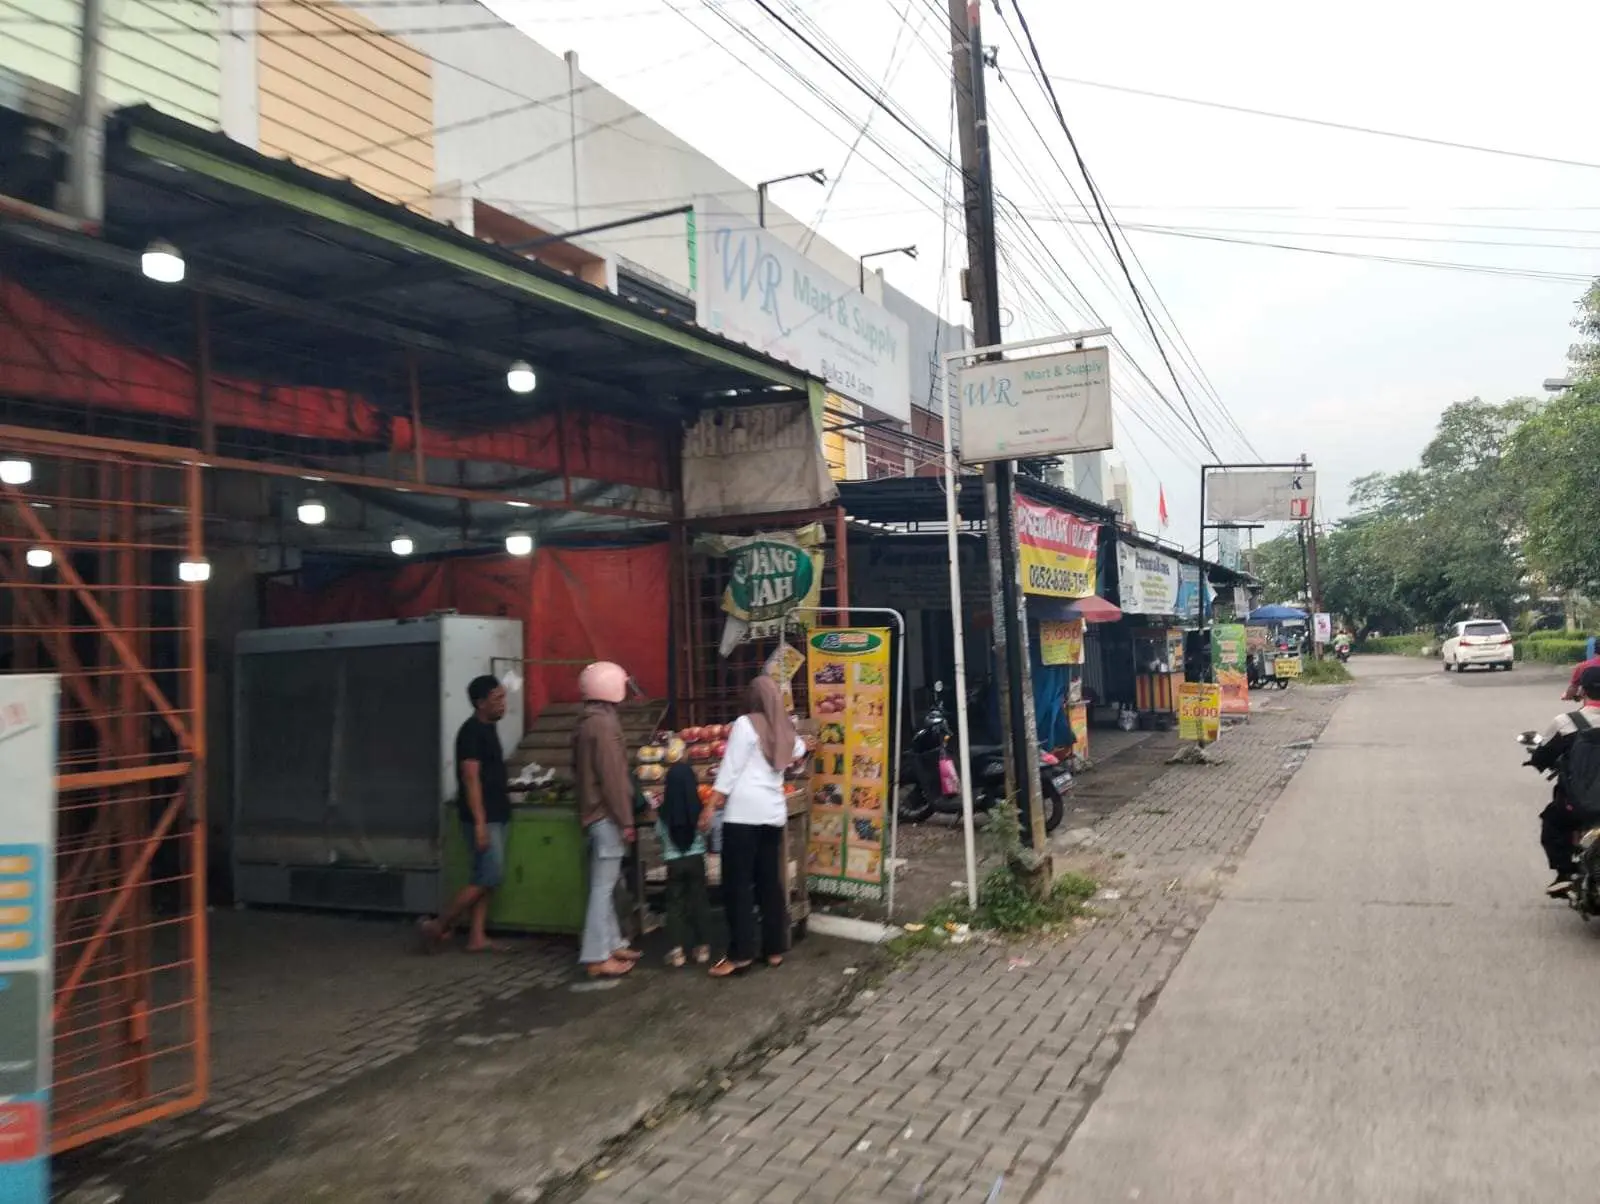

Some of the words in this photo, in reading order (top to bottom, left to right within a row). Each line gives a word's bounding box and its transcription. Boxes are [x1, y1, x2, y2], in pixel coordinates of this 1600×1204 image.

[715, 227, 791, 336] WR
[793, 267, 833, 320] Mart
[837, 295, 850, 329] &
[852, 304, 898, 364] Supply
[1023, 366, 1051, 381] Mart
[1053, 364, 1063, 377] &
[1065, 359, 1104, 377] Supply
[963, 375, 1018, 409] WR
[1291, 475, 1303, 490] K
[1181, 703, 1219, 718] 5.000
